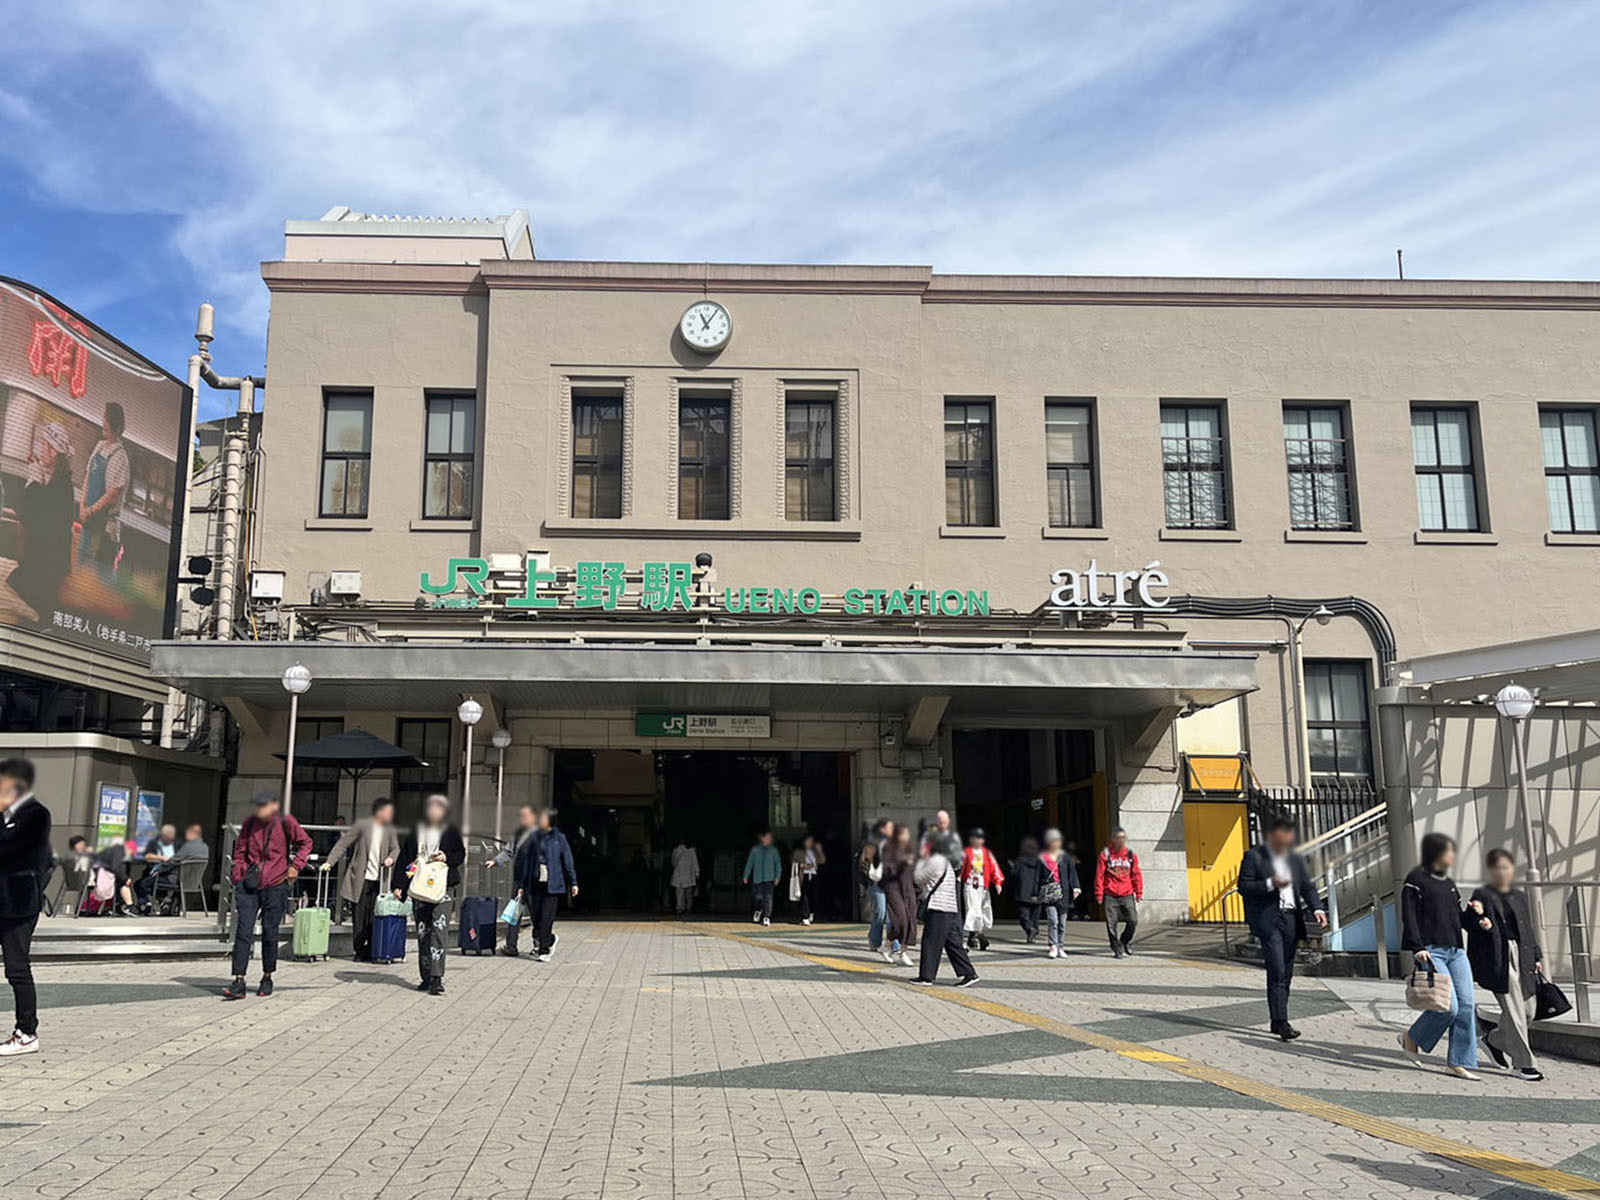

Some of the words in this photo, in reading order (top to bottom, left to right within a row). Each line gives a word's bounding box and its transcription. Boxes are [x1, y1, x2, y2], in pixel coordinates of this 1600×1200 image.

[419, 557, 489, 596] JR
[506, 559, 693, 612] 上野駅
[1050, 558, 1170, 609] atré
[724, 587, 821, 614] UENO
[844, 588, 990, 616] STATION
[662, 717, 684, 730] JR
[689, 717, 717, 727] 上野駅
